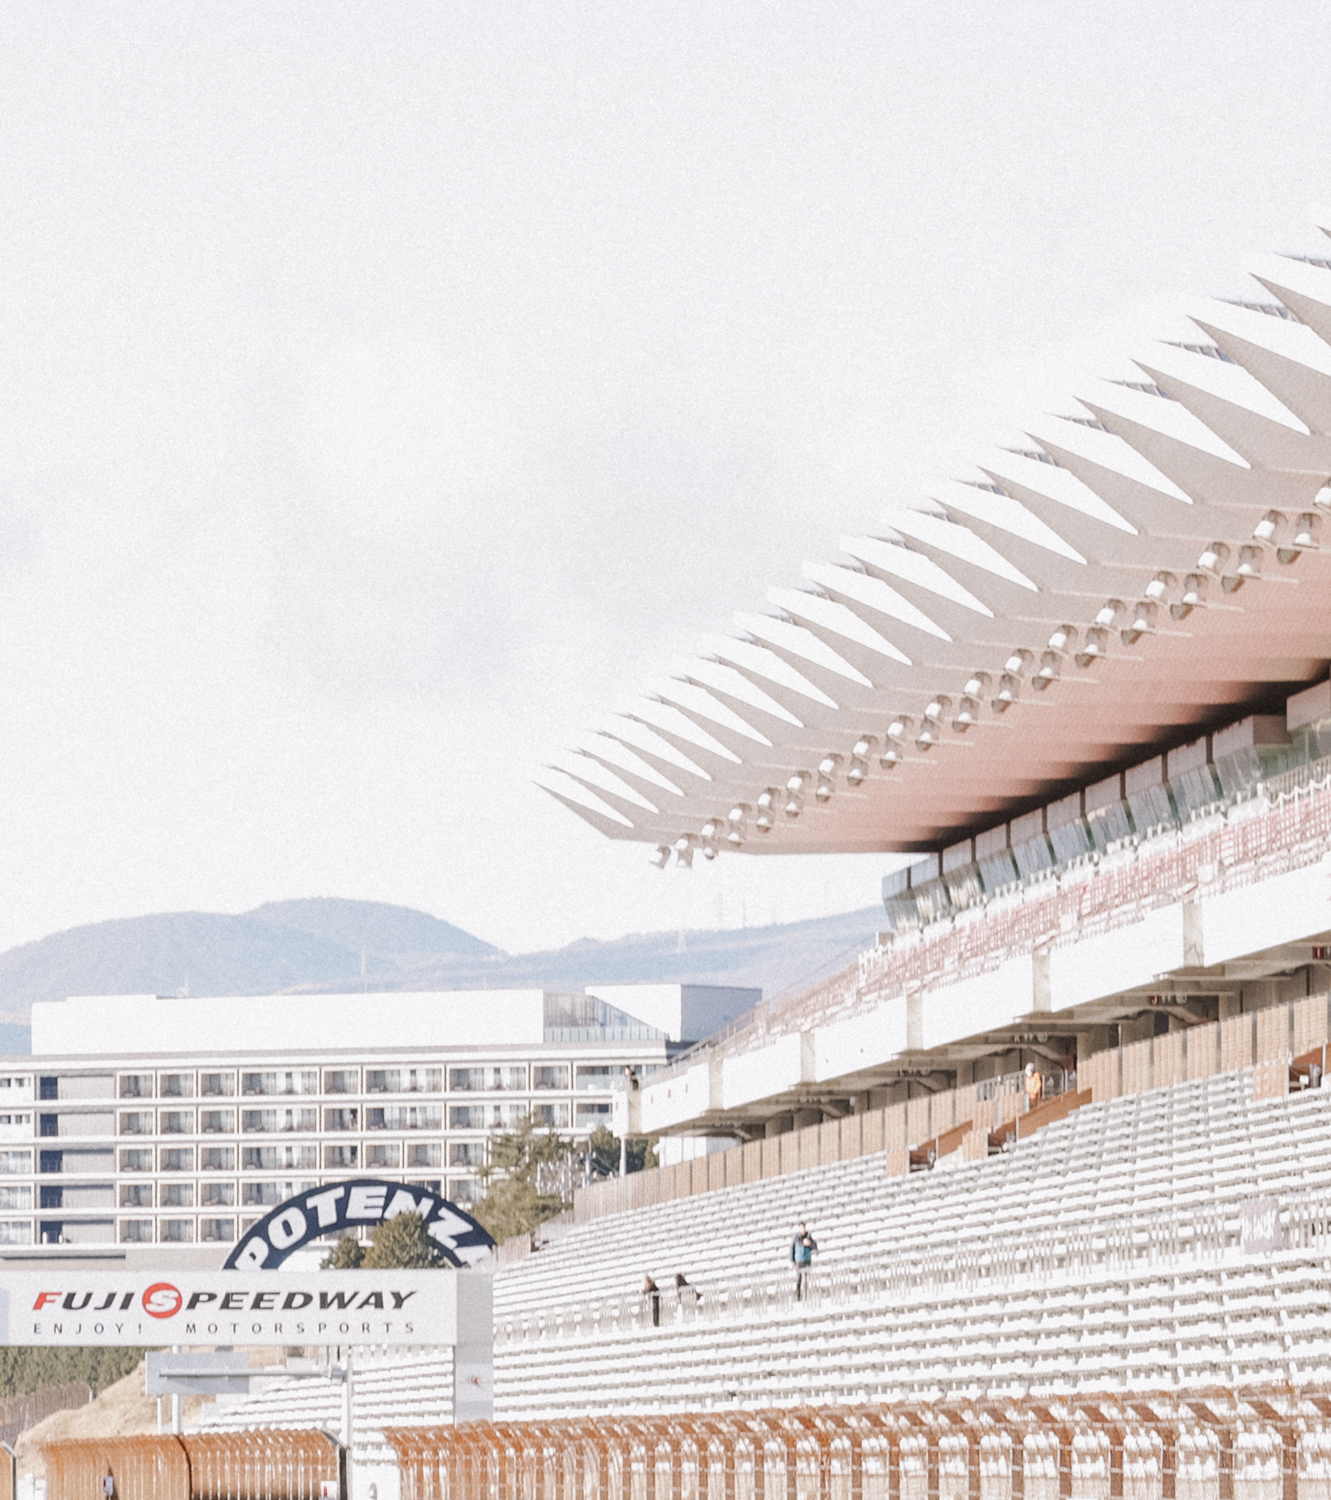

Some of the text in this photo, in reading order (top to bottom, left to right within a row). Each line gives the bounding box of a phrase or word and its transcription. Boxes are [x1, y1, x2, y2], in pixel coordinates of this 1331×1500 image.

[32, 1283, 417, 1318] FUJI SPEEDWAY
[33, 1322, 416, 1335] ENJOY! MOTORSPORTS
